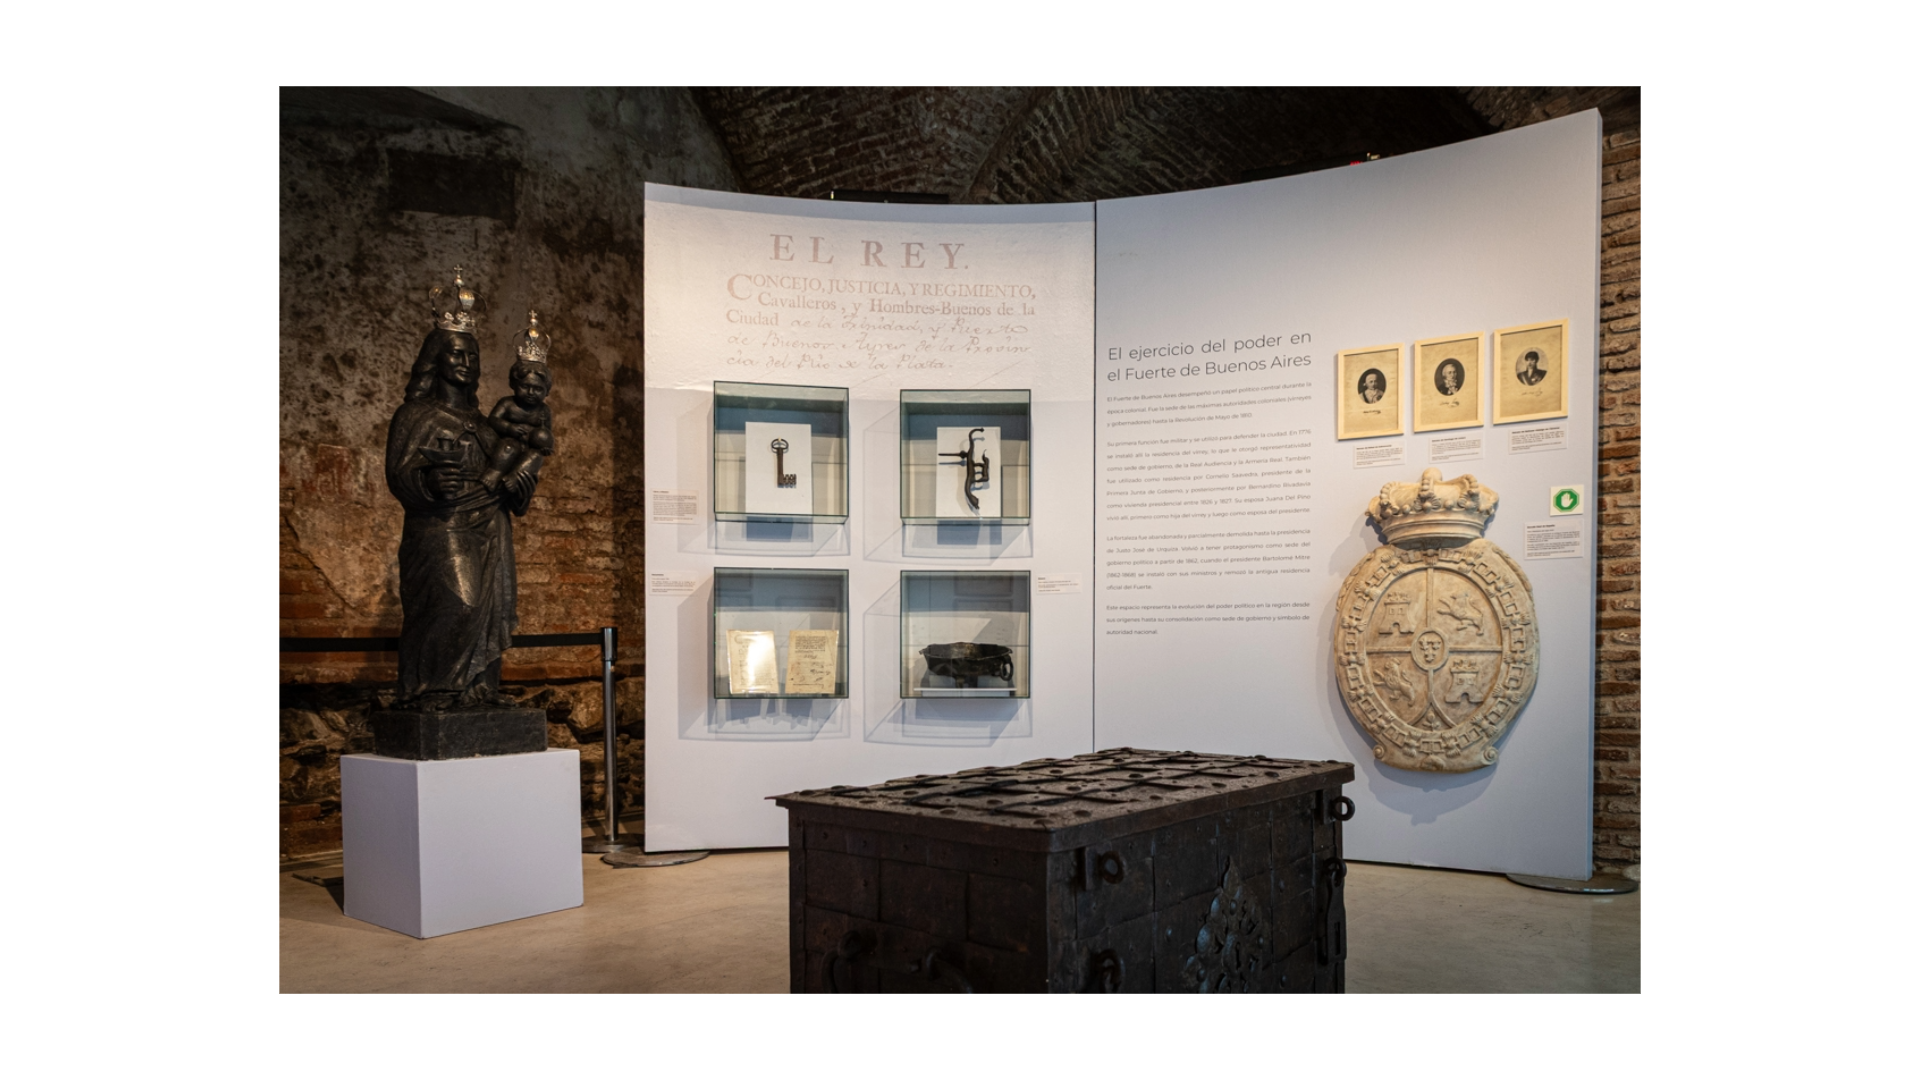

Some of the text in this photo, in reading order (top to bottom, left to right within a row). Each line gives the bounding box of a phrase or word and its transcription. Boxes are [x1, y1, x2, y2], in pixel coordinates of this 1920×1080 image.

[769, 233, 969, 270] EL REY.
[727, 273, 1037, 301] CONCEJO, JUSTICIA, Y REGIMIENTO,
[726, 309, 779, 327] Ciudad
[817, 315, 833, 330] la
[852, 302, 862, 315] y
[869, 298, 991, 316] Hombres-Buenos
[996, 302, 1014, 316] de
[1022, 302, 1036, 316] la
[1108, 332, 1312, 362] El ejercicio del poder en
[1107, 353, 1312, 382] el Fuerte de Buenos Aires
